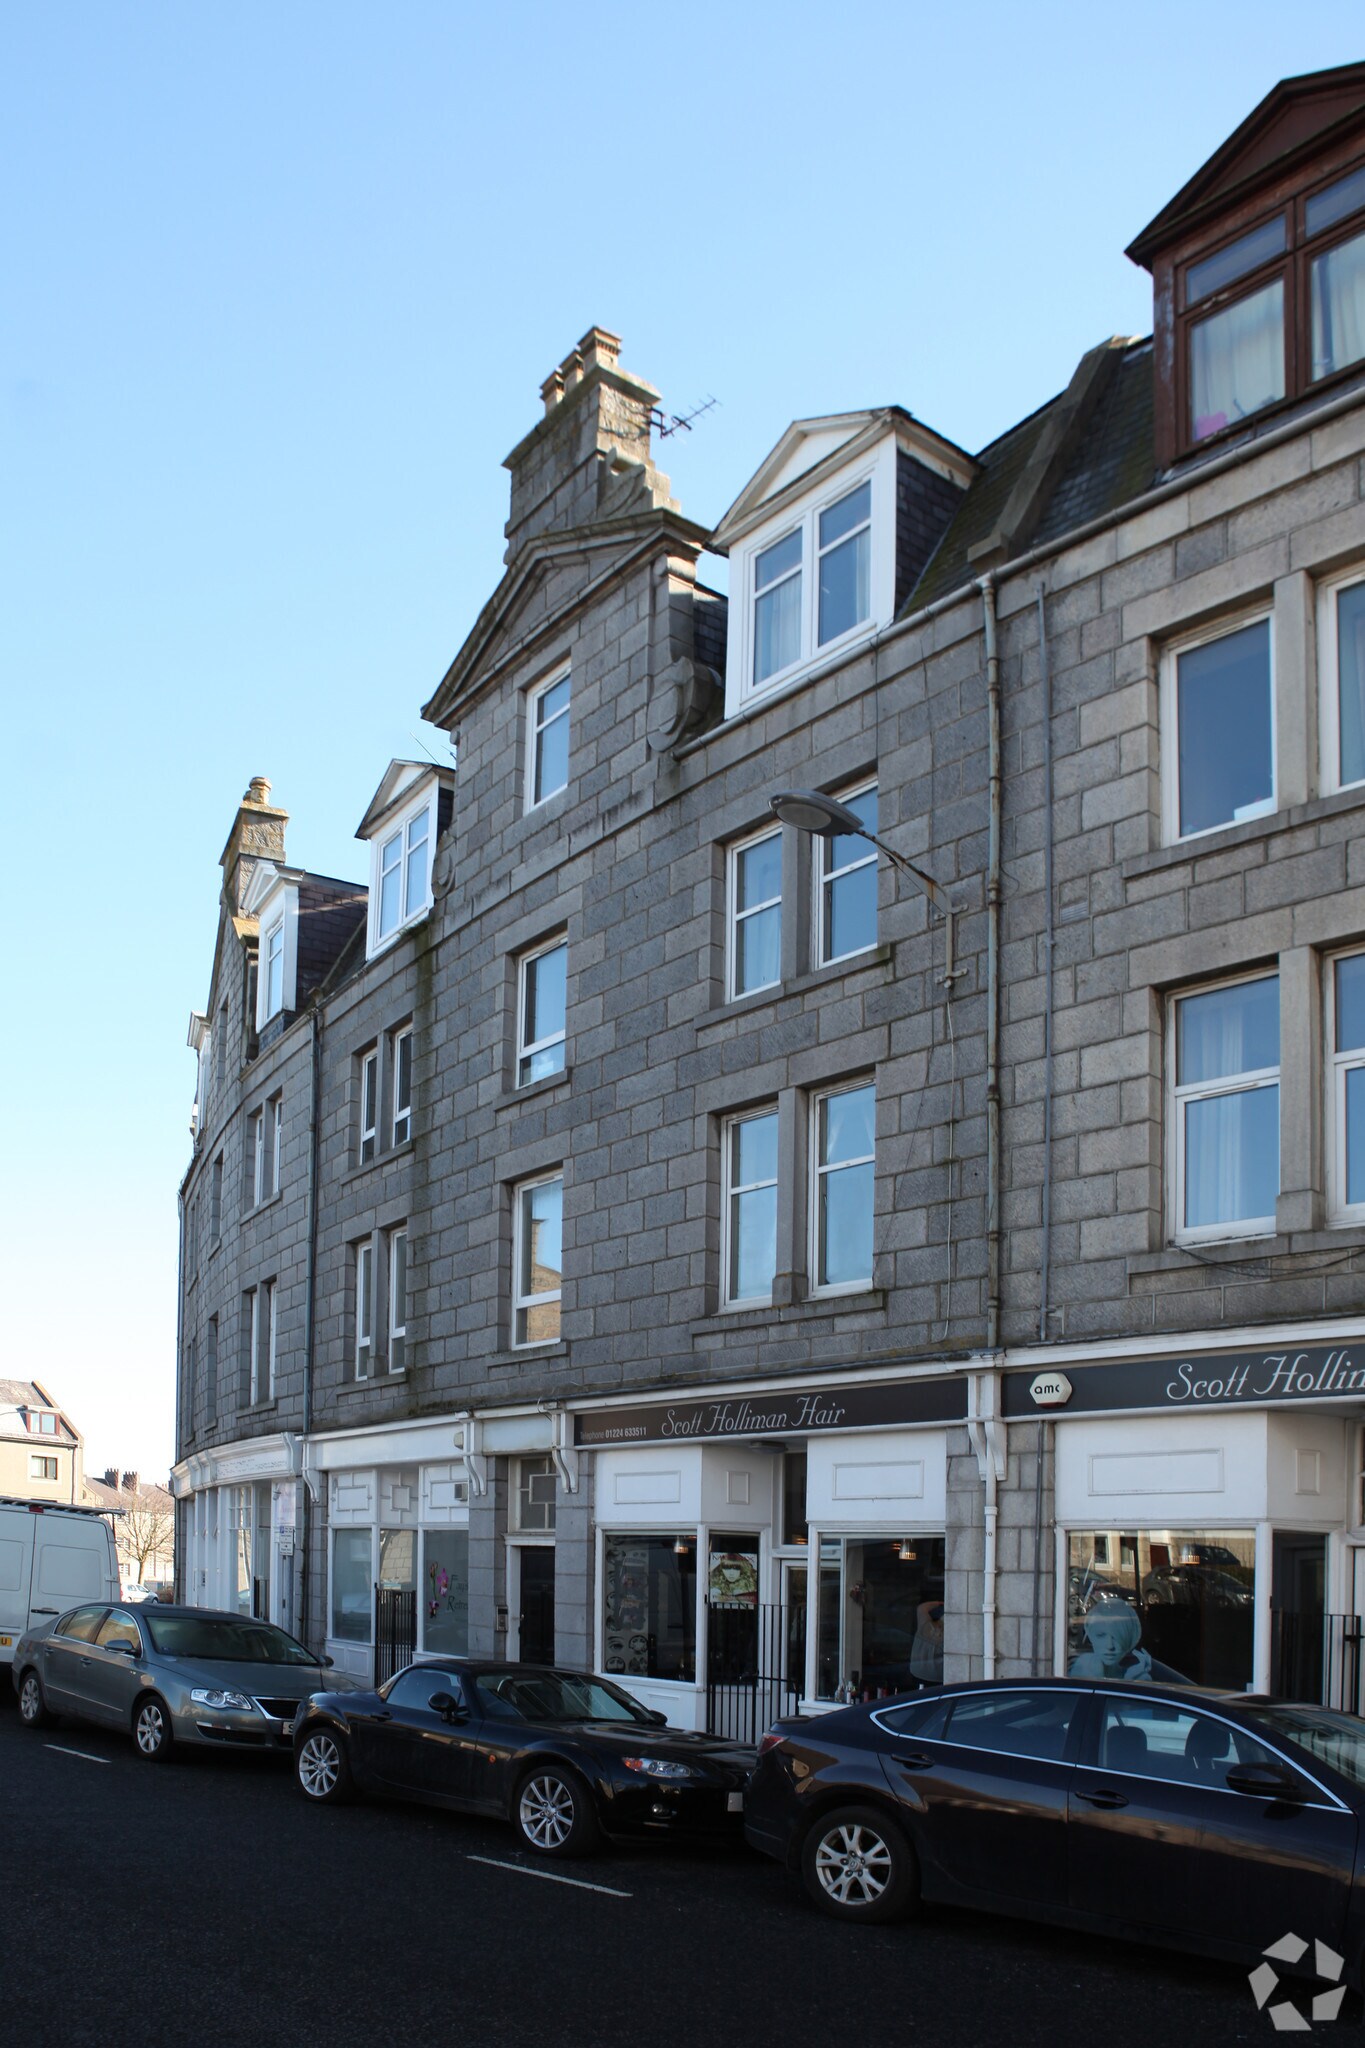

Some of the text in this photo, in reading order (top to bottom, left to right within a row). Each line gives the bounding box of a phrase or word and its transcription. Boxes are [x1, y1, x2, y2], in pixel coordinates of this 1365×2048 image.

[1034, 1384, 1060, 1394] amc
[1166, 1363, 1250, 1400] Scott
[661, 1395, 846, 1436] Scott Holliman Hair
[580, 1426, 647, 1441] Telephone 01224 633511
